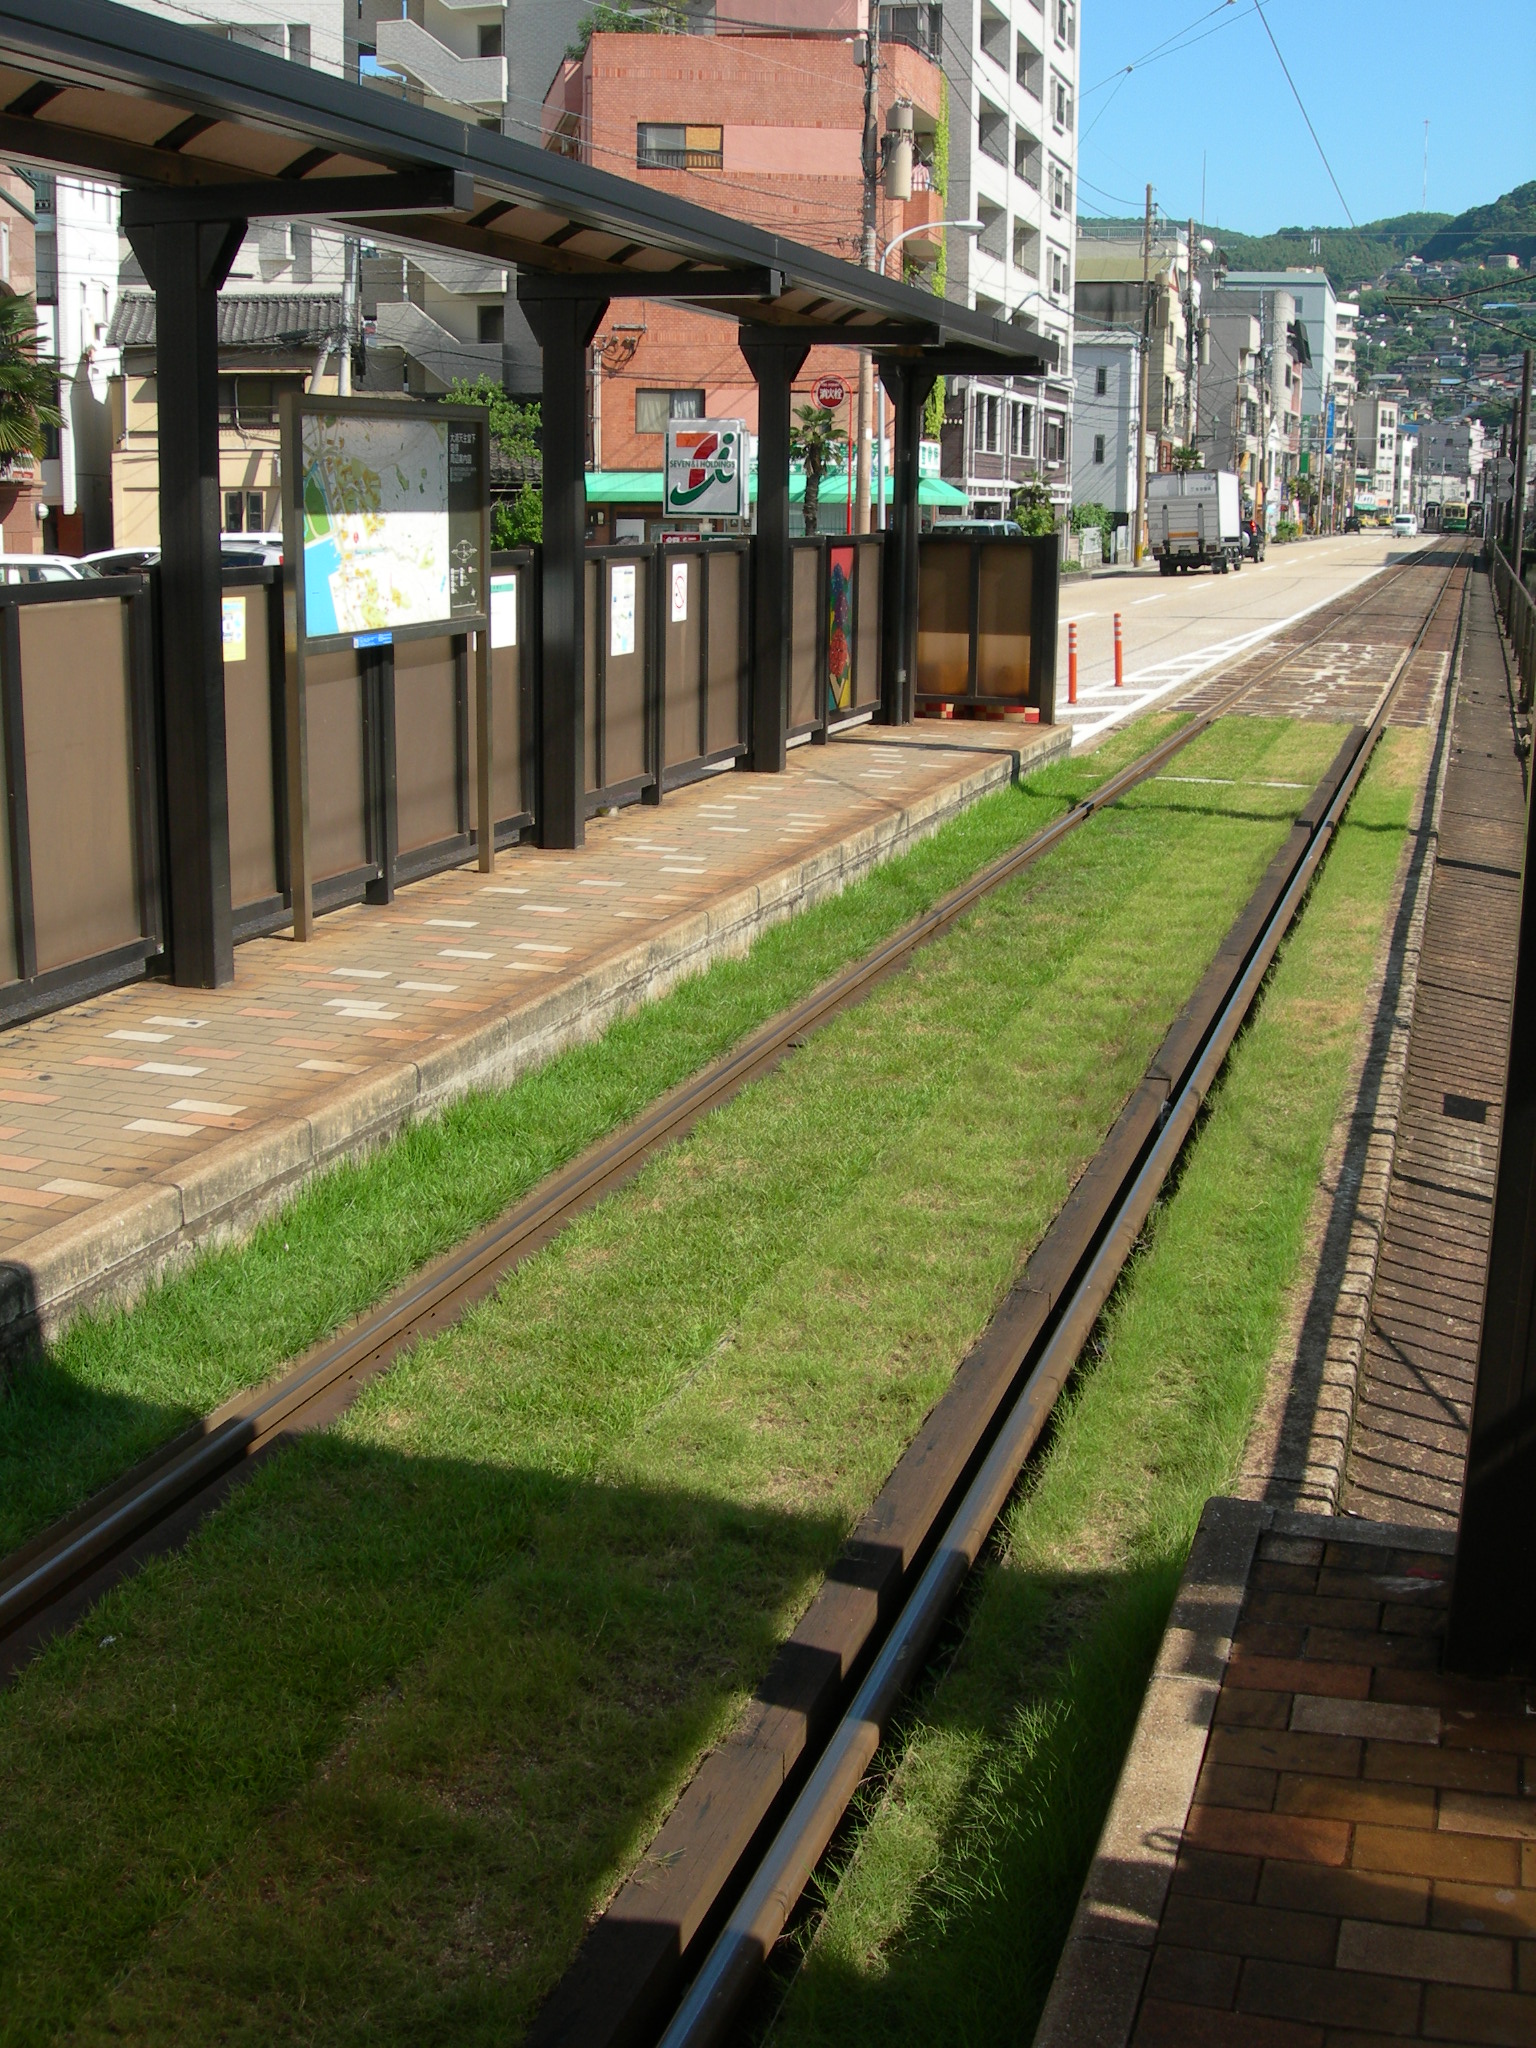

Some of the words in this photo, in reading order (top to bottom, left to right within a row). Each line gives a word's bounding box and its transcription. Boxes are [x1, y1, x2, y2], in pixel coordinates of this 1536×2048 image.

[820, 388, 842, 400] 消火栓
[700, 459, 736, 468] HOLDINGS
